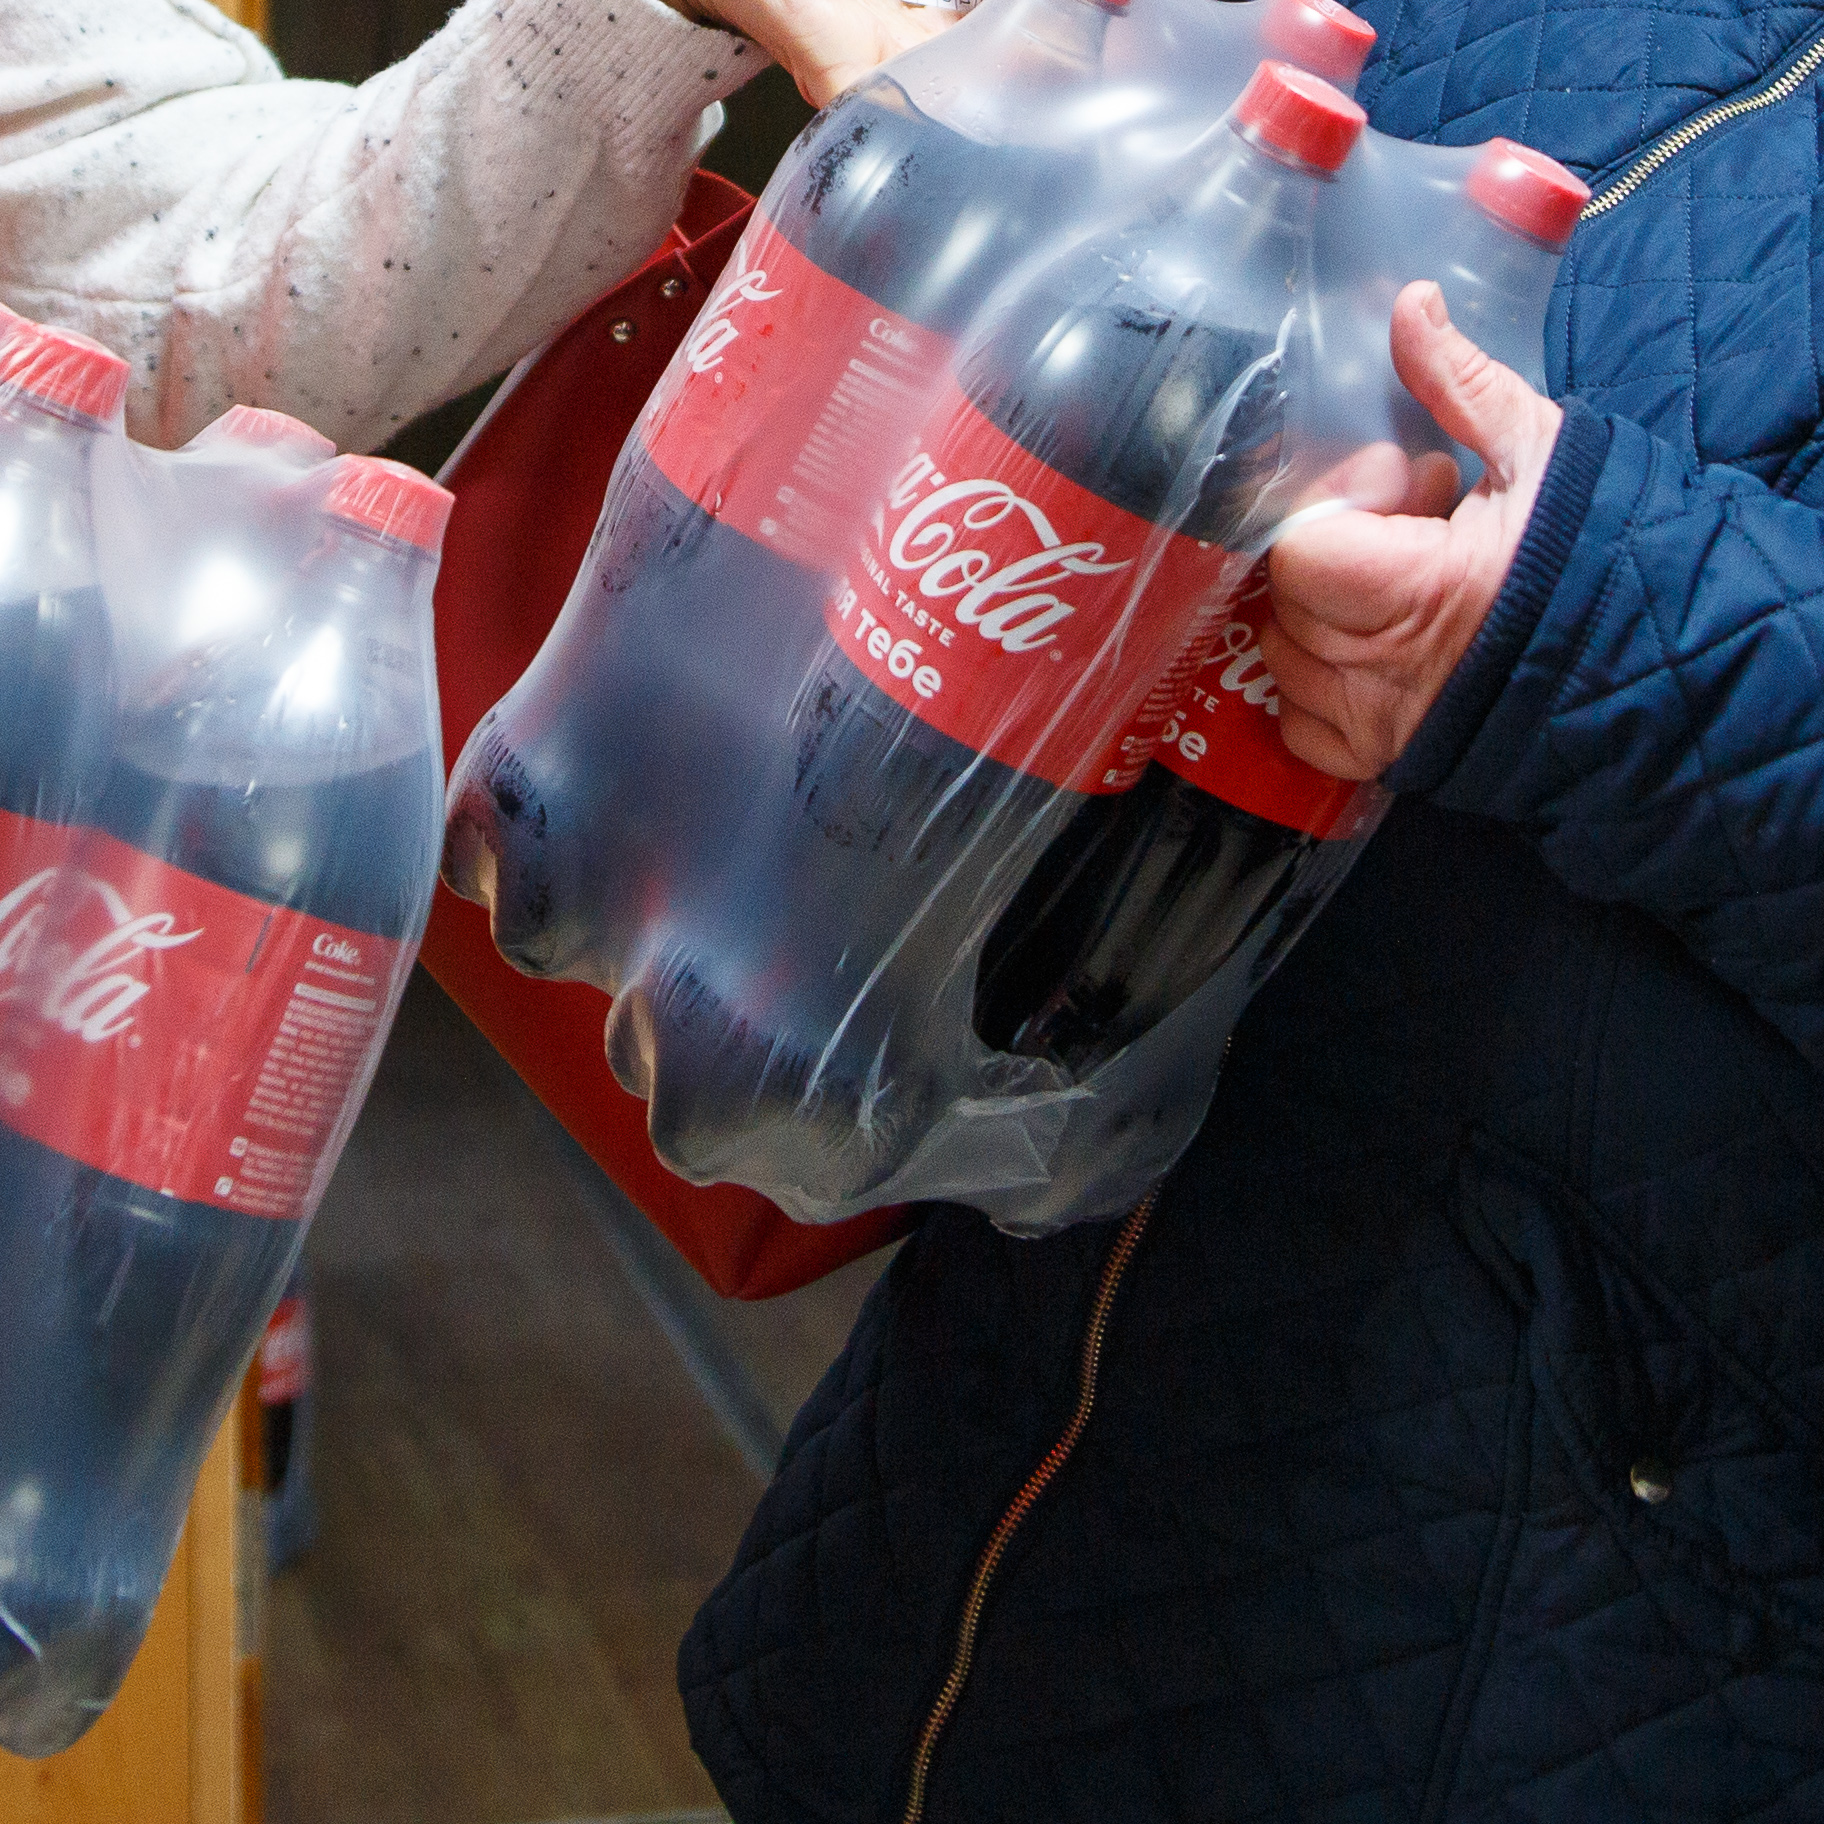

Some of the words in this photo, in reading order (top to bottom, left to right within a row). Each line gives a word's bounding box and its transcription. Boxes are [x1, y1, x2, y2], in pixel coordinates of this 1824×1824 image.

[876, 451, 1134, 654] a-Cola
[854, 608, 943, 699] тебе
[894, 589, 958, 649] TASTE
[1193, 686, 1220, 713] TE
